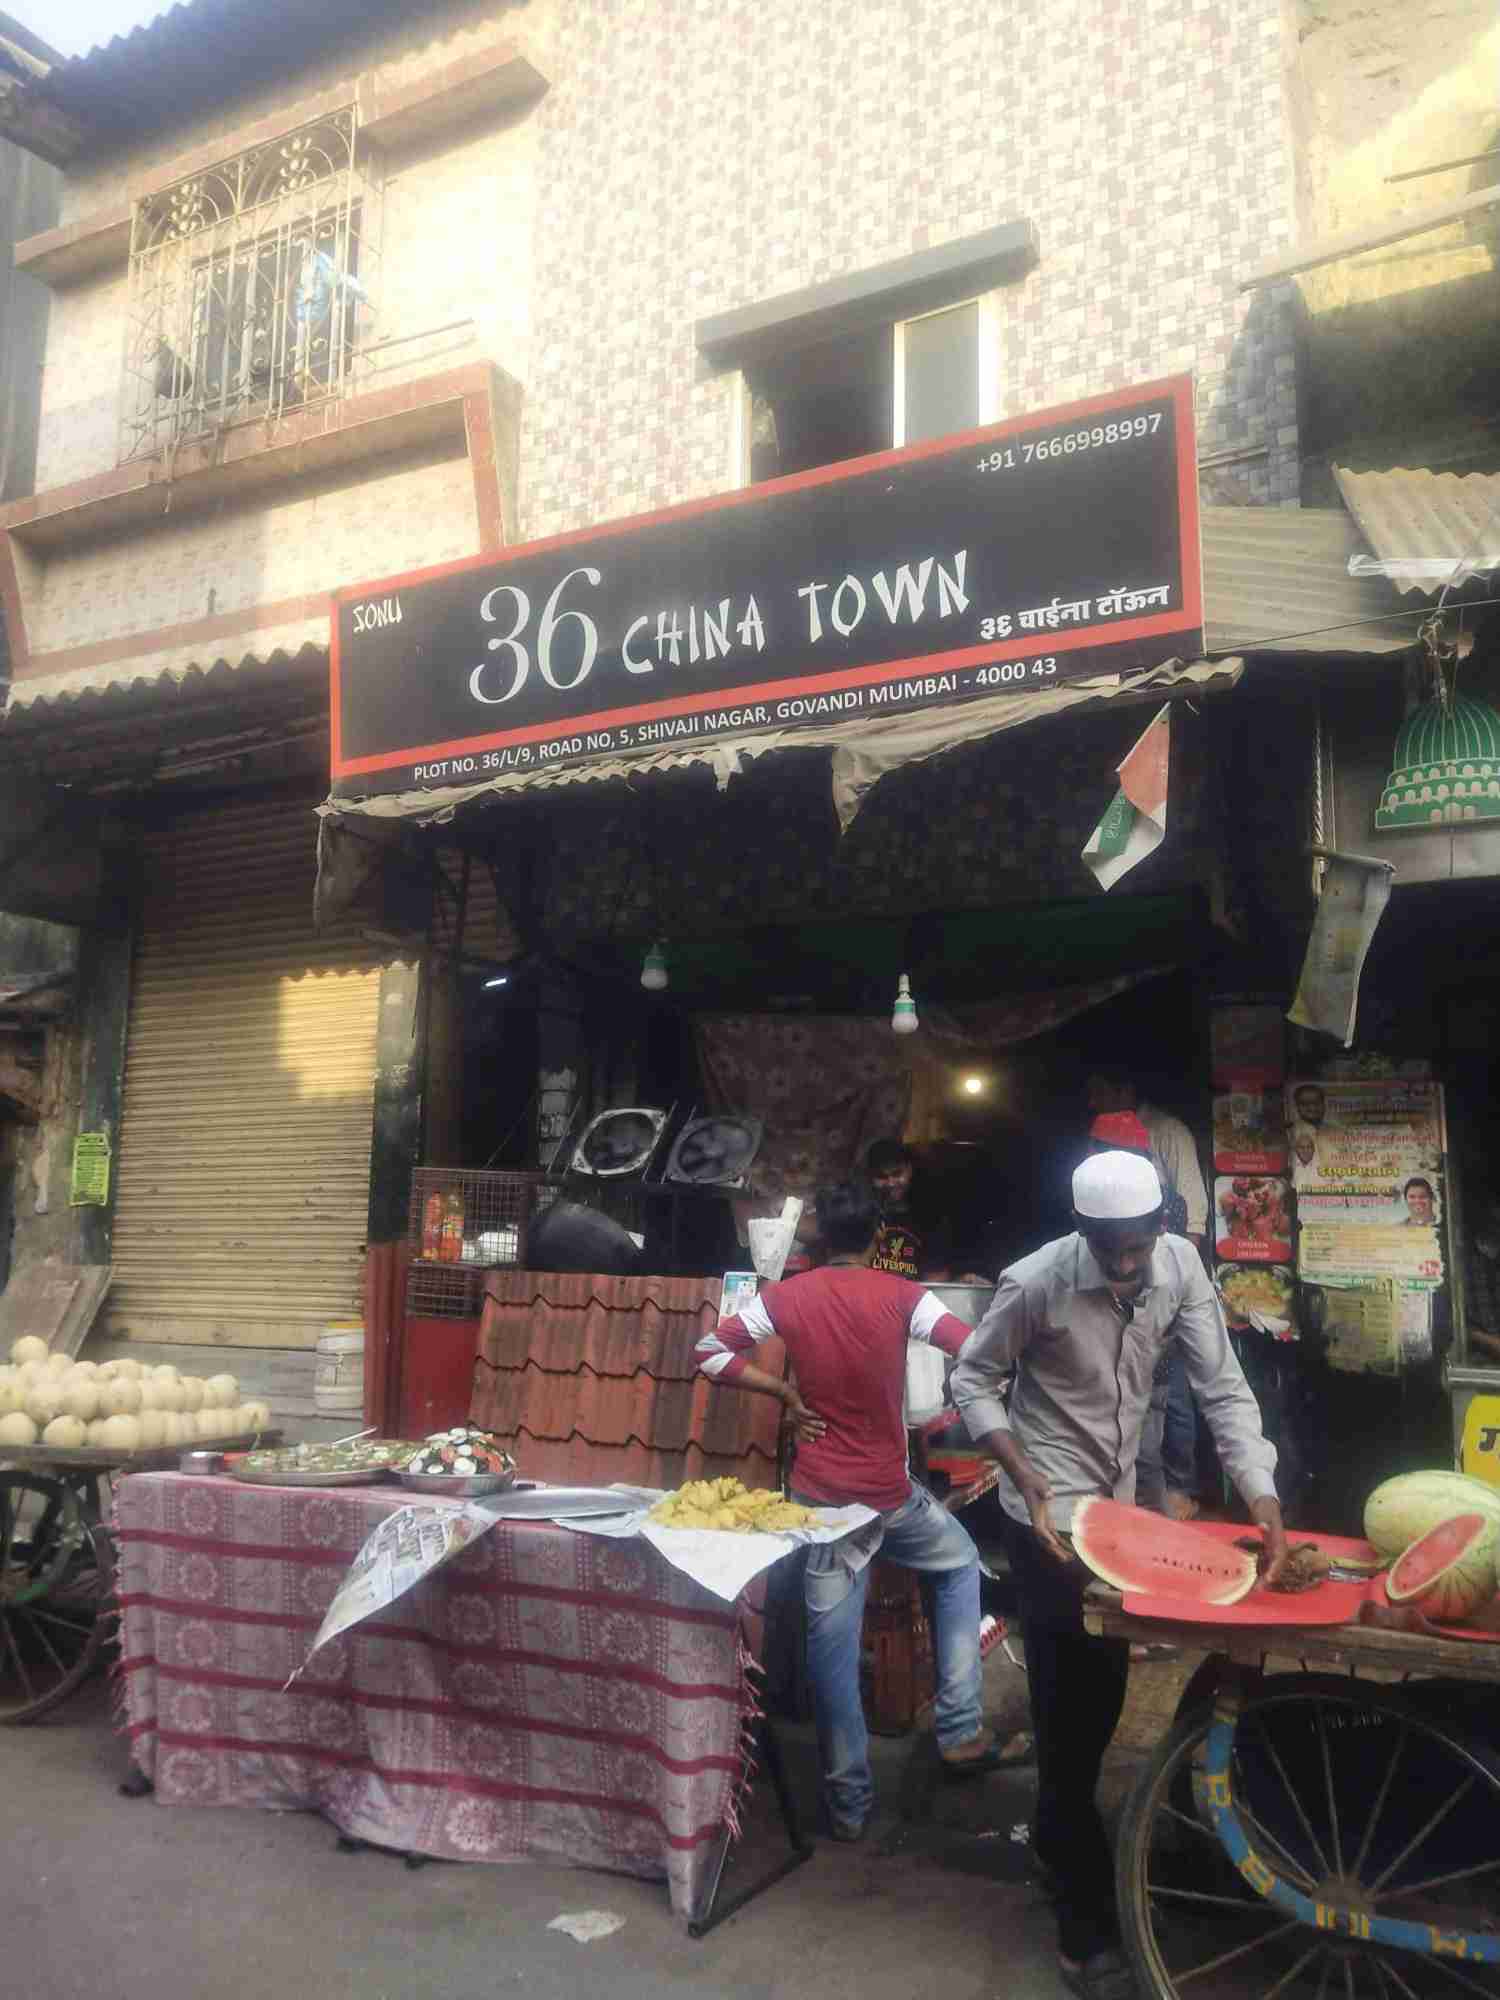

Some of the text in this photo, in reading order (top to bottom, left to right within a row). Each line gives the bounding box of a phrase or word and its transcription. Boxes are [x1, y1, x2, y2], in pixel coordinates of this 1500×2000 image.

[976, 413, 1162, 472] +91 7666998997
[352, 596, 403, 633] SONU
[469, 550, 970, 704] 36 CHINA TOWN
[979, 585, 1170, 640] ३६ चाईना टॉऊन
[413, 762, 448, 781] PLOT
[451, 757, 479, 774] NO.
[482, 747, 535, 769] 36/L/9,
[539, 738, 582, 760] ROAD
[586, 731, 616, 751] NO,
[619, 729, 635, 746] 5,
[638, 715, 700, 742] SHIVAJI
[703, 706, 772, 732] NAGAR,
[776, 690, 864, 719] GOVANDI
[869, 674, 957, 704] MUMBAI
[975, 662, 1026, 687] 4000
[1031, 657, 1058, 676] 43
